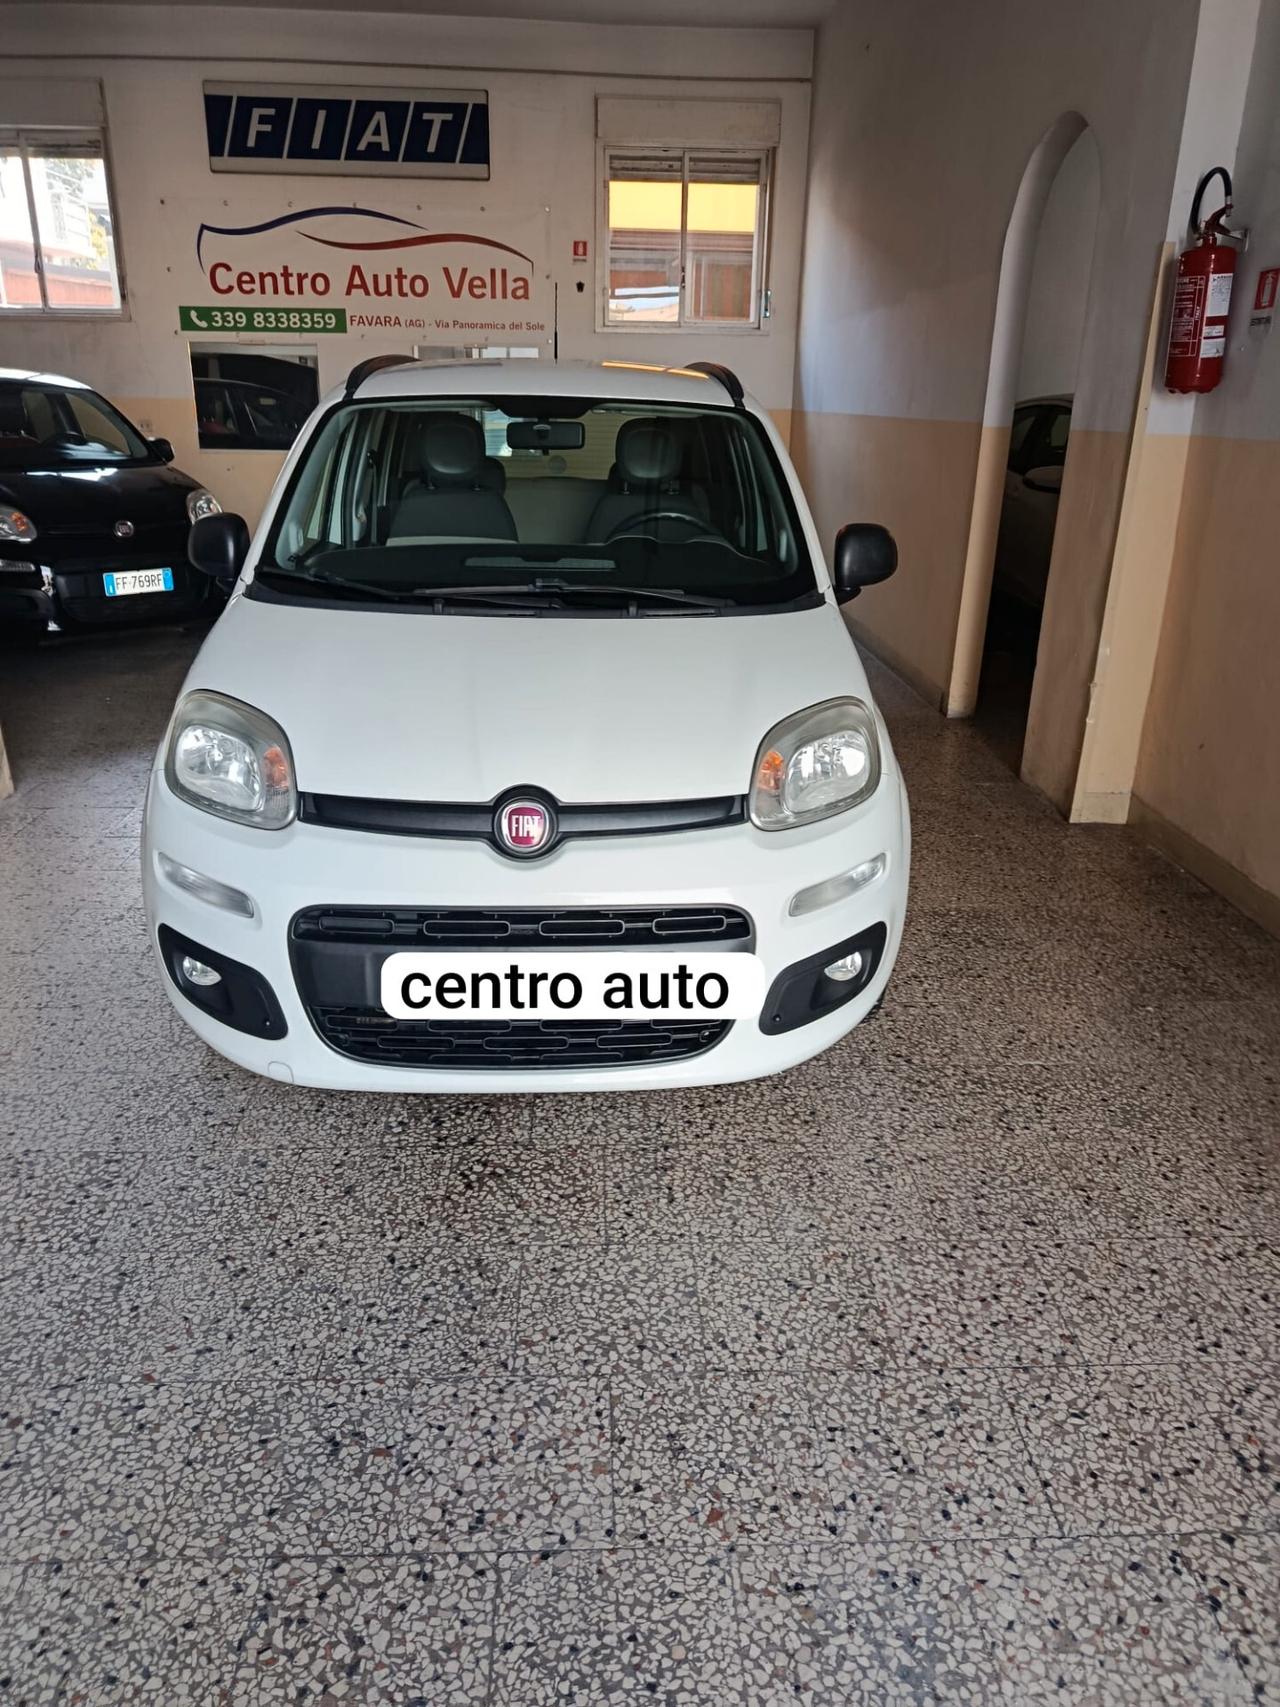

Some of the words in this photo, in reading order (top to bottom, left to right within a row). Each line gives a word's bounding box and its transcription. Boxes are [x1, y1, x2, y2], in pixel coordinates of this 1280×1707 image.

[246, 107, 454, 154] FIAT
[209, 262, 331, 295] Centro
[345, 264, 429, 297] Auto
[442, 267, 530, 300] Vella
[211, 311, 247, 328] 339
[253, 312, 336, 329] 8338359
[350, 315, 401, 327] FAVARA
[405, 319, 426, 329] (AG)
[435, 319, 450, 329] Via
[452, 320, 506, 330] Panoramica
[509, 321, 523, 331] del
[525, 321, 545, 331] Sole
[511, 815, 541, 838] FIAT
